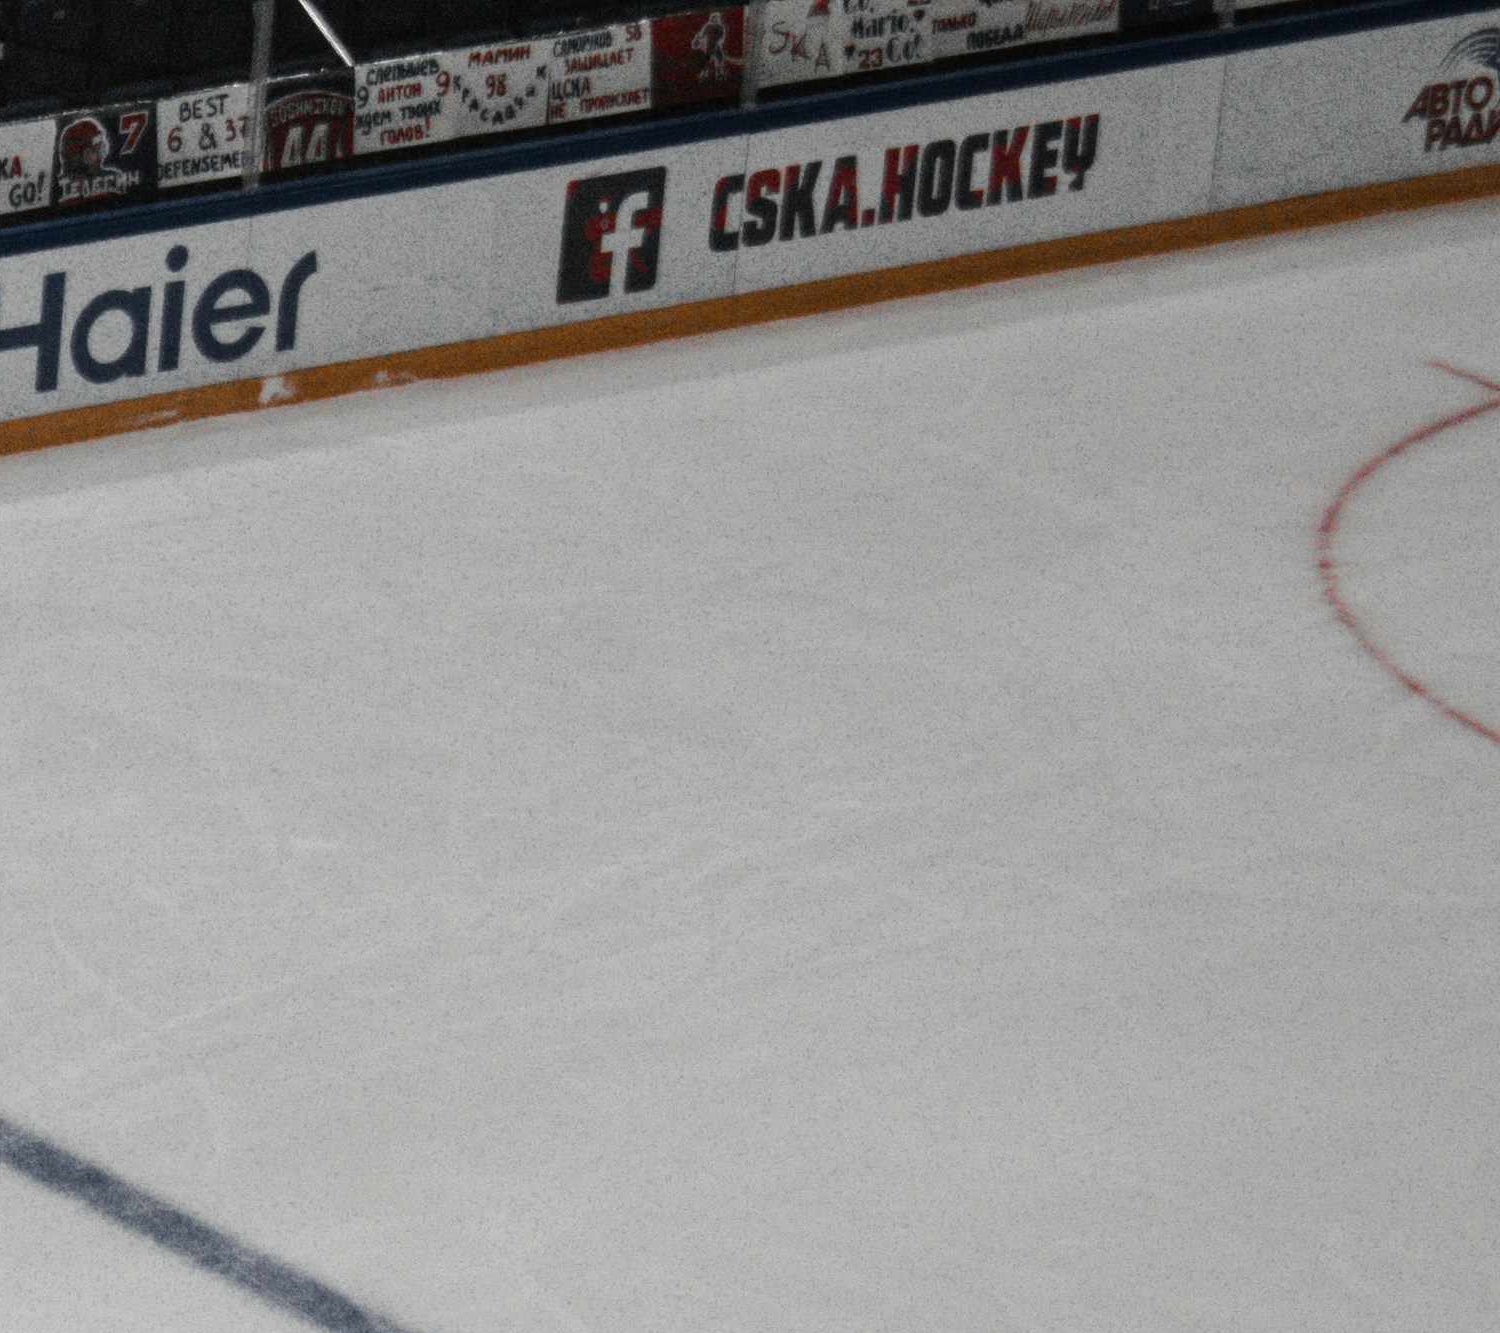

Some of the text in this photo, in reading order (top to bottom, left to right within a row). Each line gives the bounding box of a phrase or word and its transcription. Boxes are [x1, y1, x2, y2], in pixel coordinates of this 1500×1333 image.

[180, 94, 228, 122] BEST
[1401, 76, 1494, 124] АВТО
[120, 110, 148, 155] 7
[167, 127, 183, 152] 6
[9, 172, 45, 207] GO!
[707, 113, 1101, 252] CSKA.HOCKEY
